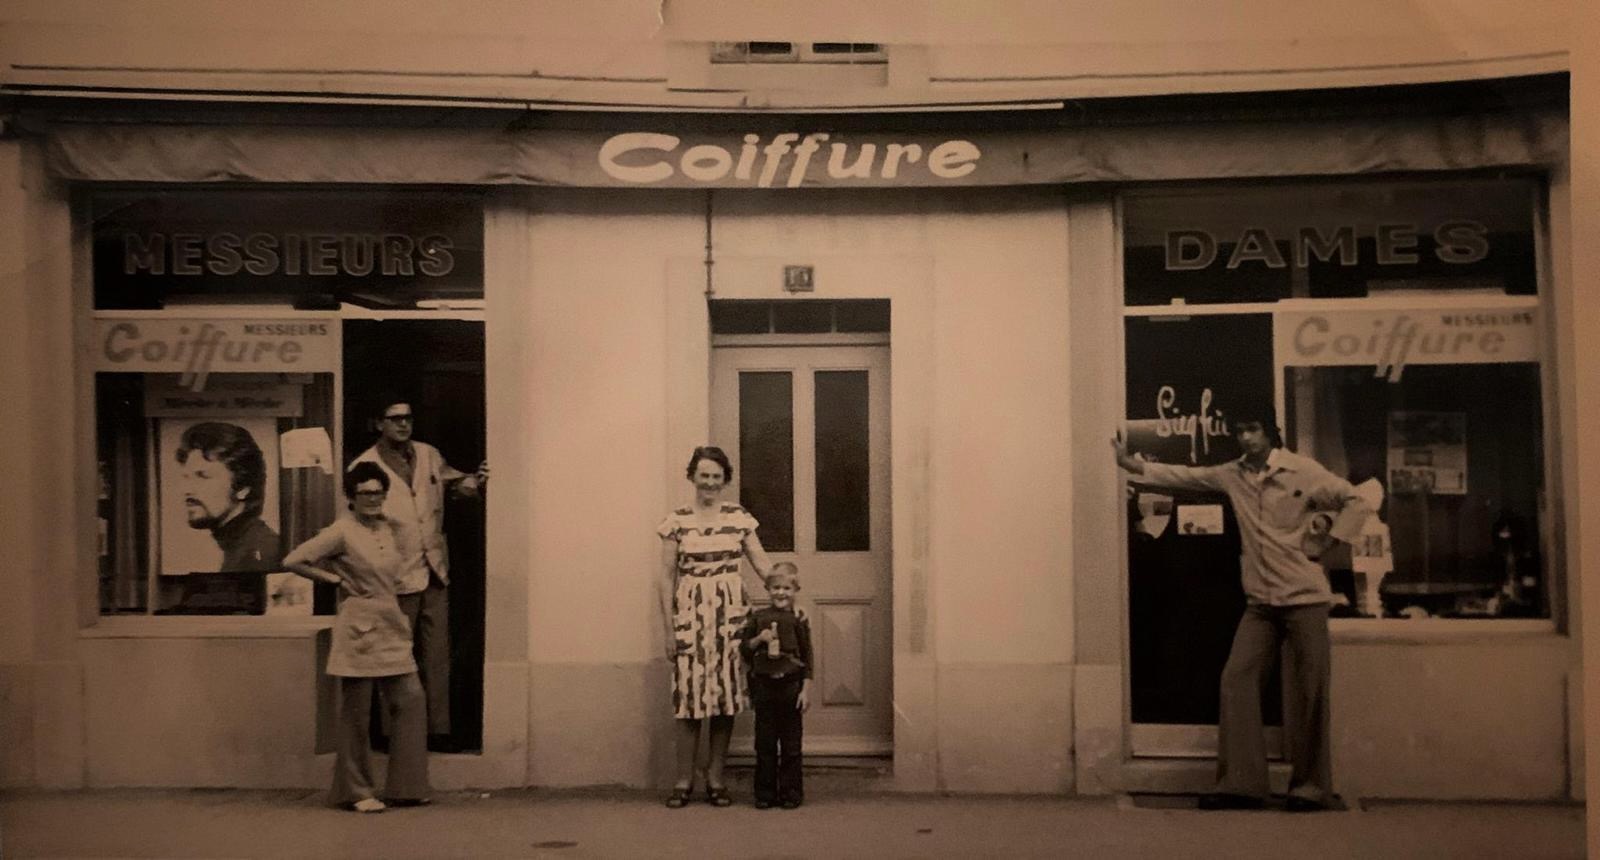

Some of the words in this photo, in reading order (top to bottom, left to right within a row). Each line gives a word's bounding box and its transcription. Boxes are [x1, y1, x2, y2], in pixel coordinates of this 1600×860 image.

[599, 132, 981, 188] Coiffure
[124, 232, 454, 276] MESSIEURS
[1164, 220, 1490, 271] DAMES
[244, 324, 328, 336] MESSIEURS
[1293, 315, 1506, 383] Coiffure
[104, 323, 303, 392] Coiffure
